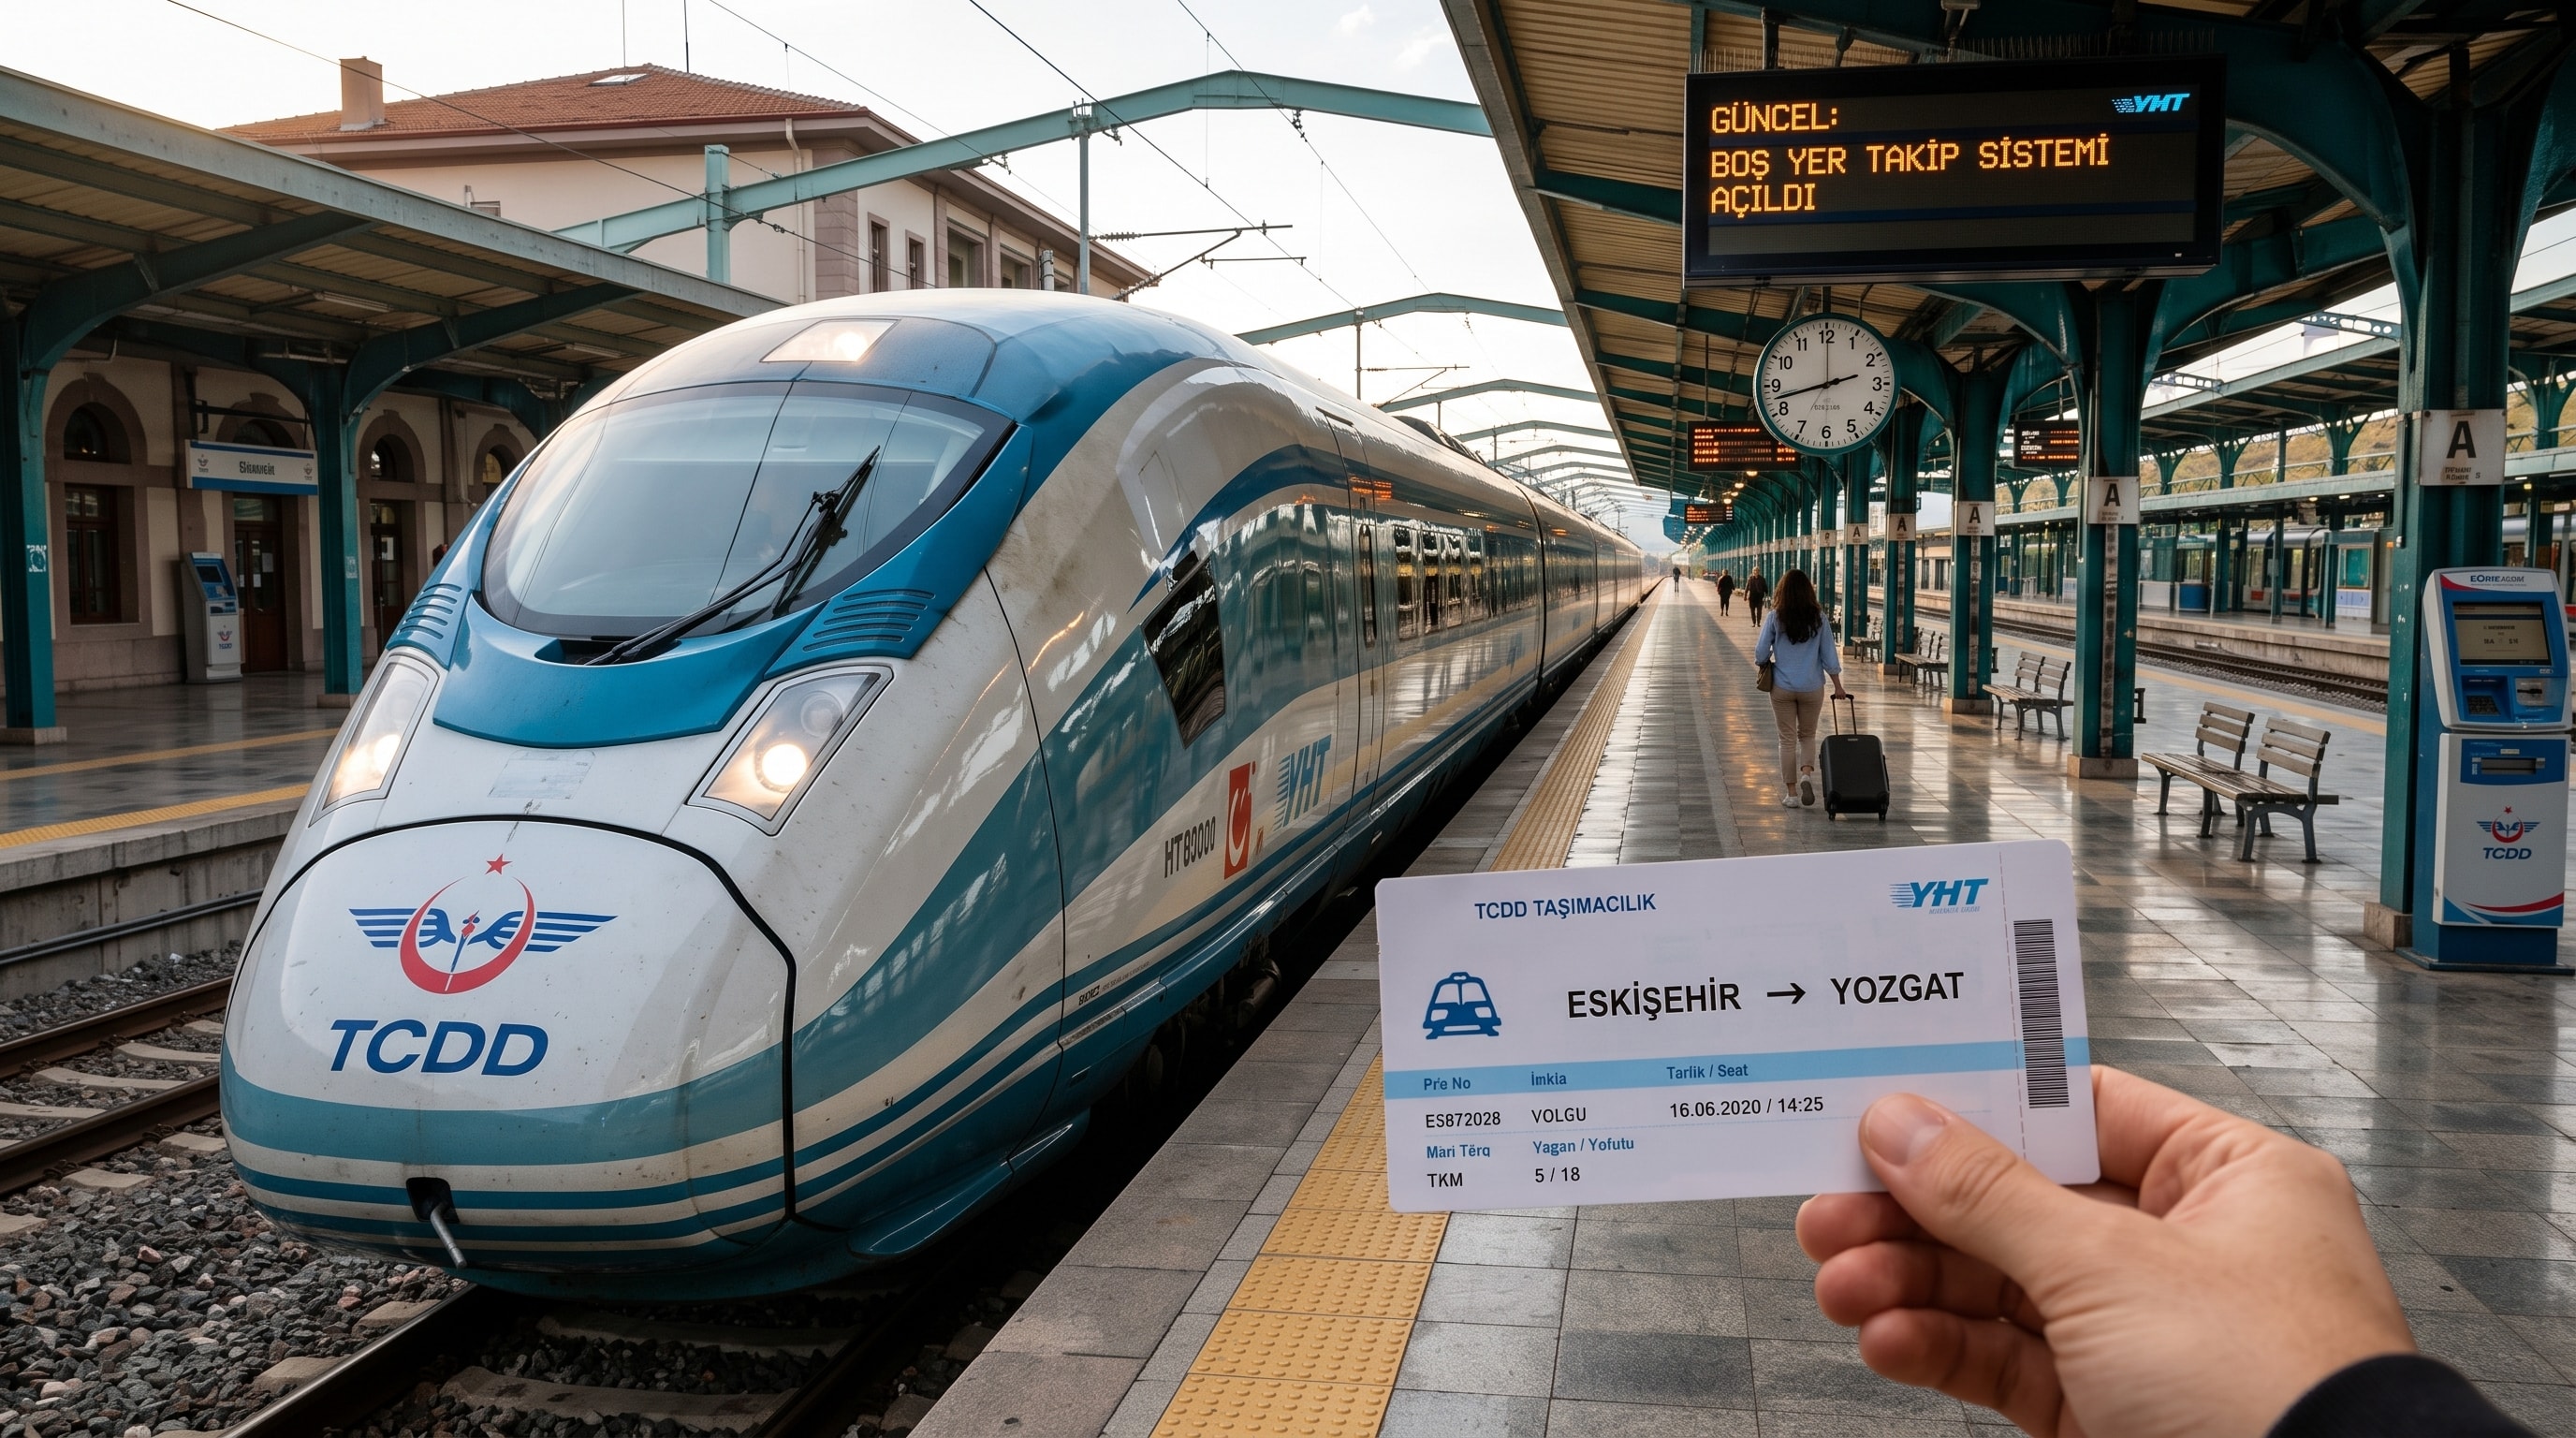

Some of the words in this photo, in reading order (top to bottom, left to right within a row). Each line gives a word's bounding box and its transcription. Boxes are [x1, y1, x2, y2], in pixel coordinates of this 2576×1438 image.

[1711, 101, 1837, 133] GÜNCEL:
[1711, 150, 1770, 181] BOŞ
[1789, 147, 1846, 175] YER
[1866, 139, 1959, 173] TAKİP
[1979, 133, 2109, 169] SİSTEMİ
[1711, 183, 1816, 218] AÇILDI
[1796, 338, 1808, 351] 11
[1819, 330, 1835, 344] 12
[1850, 337, 1854, 349] 1
[1778, 356, 1793, 370] 10
[1866, 353, 1875, 367] 2
[1771, 378, 1781, 392] 9
[1872, 376, 1882, 391] 3
[1778, 402, 1789, 416] 8
[1864, 401, 1874, 415] 4
[1797, 420, 1807, 433] 7
[1822, 426, 1831, 439] 6
[1846, 419, 1856, 433] 5
[2446, 420, 2477, 459] A
[2103, 483, 2121, 506] A
[1969, 506, 1982, 524] A
[1852, 526, 1861, 537] A
[1896, 517, 1907, 532] A
[1282, 734, 1332, 828] YHT
[2482, 847, 2532, 860] TCDD
[1910, 878, 1989, 908] YHT
[1474, 901, 1528, 919] TCDD
[1533, 893, 1657, 919] TAŞIMACILIK
[1567, 976, 1742, 1020] ESKİŞEHİR
[1830, 971, 1965, 1005] YOZGAT
[329, 1019, 549, 1077] TCDD
[1709, 1064, 1714, 1078] /
[1718, 1064, 1749, 1078] Seat
[1452, 1077, 1471, 1090] No
[1670, 1099, 1761, 1118] 16.06.2020
[1766, 1098, 1772, 1113] /
[1778, 1096, 1824, 1113] 14:25
[1426, 1111, 1501, 1128] ES872028
[1531, 1107, 1587, 1123] VOLGU
[1532, 1139, 1576, 1156] Yagan
[1580, 1137, 1585, 1152] /
[1588, 1137, 1634, 1152] Yofutu
[1427, 1172, 1463, 1188] TKM
[1535, 1168, 1544, 1183] 5
[1549, 1167, 1556, 1182] /
[1561, 1167, 1581, 1182] 18
